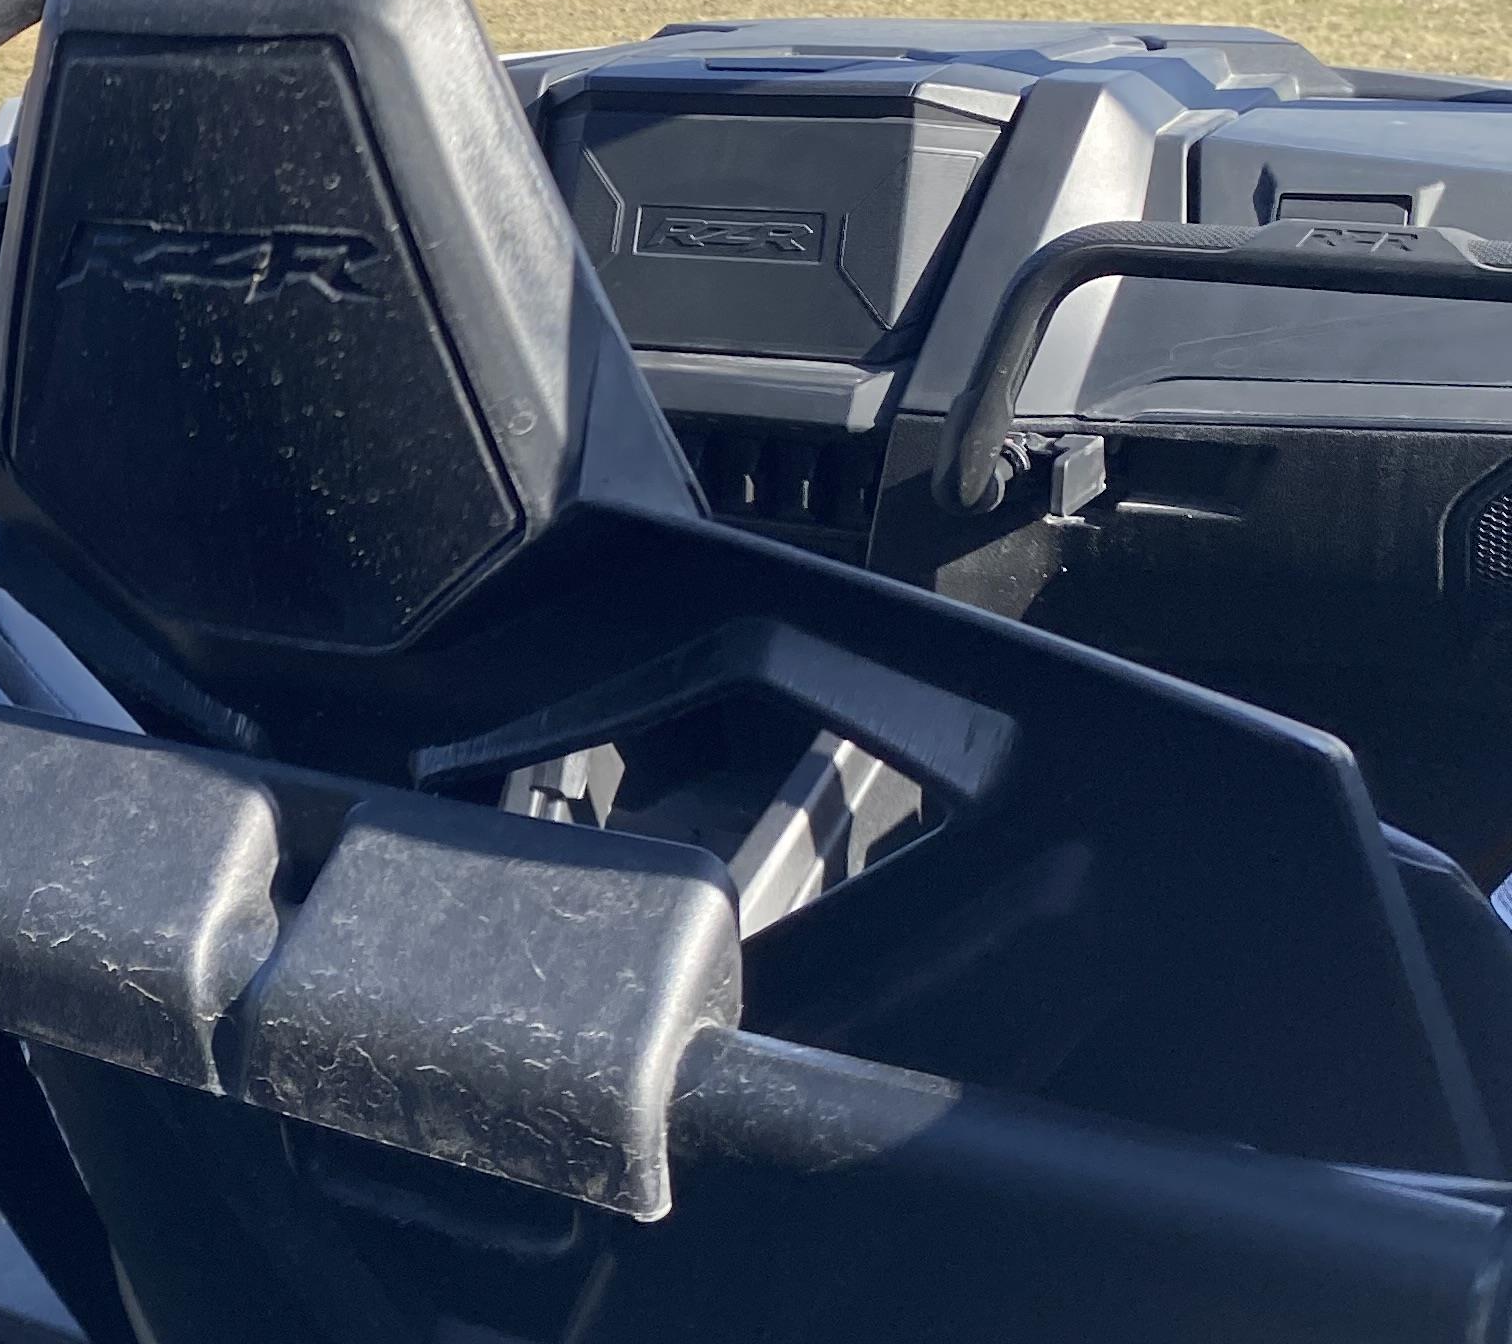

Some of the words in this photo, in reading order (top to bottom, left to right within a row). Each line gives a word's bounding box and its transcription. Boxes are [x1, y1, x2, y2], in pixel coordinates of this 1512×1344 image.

[643, 217, 814, 252] RZR
[1296, 227, 1419, 253] RZR
[55, 218, 388, 304] RZR
